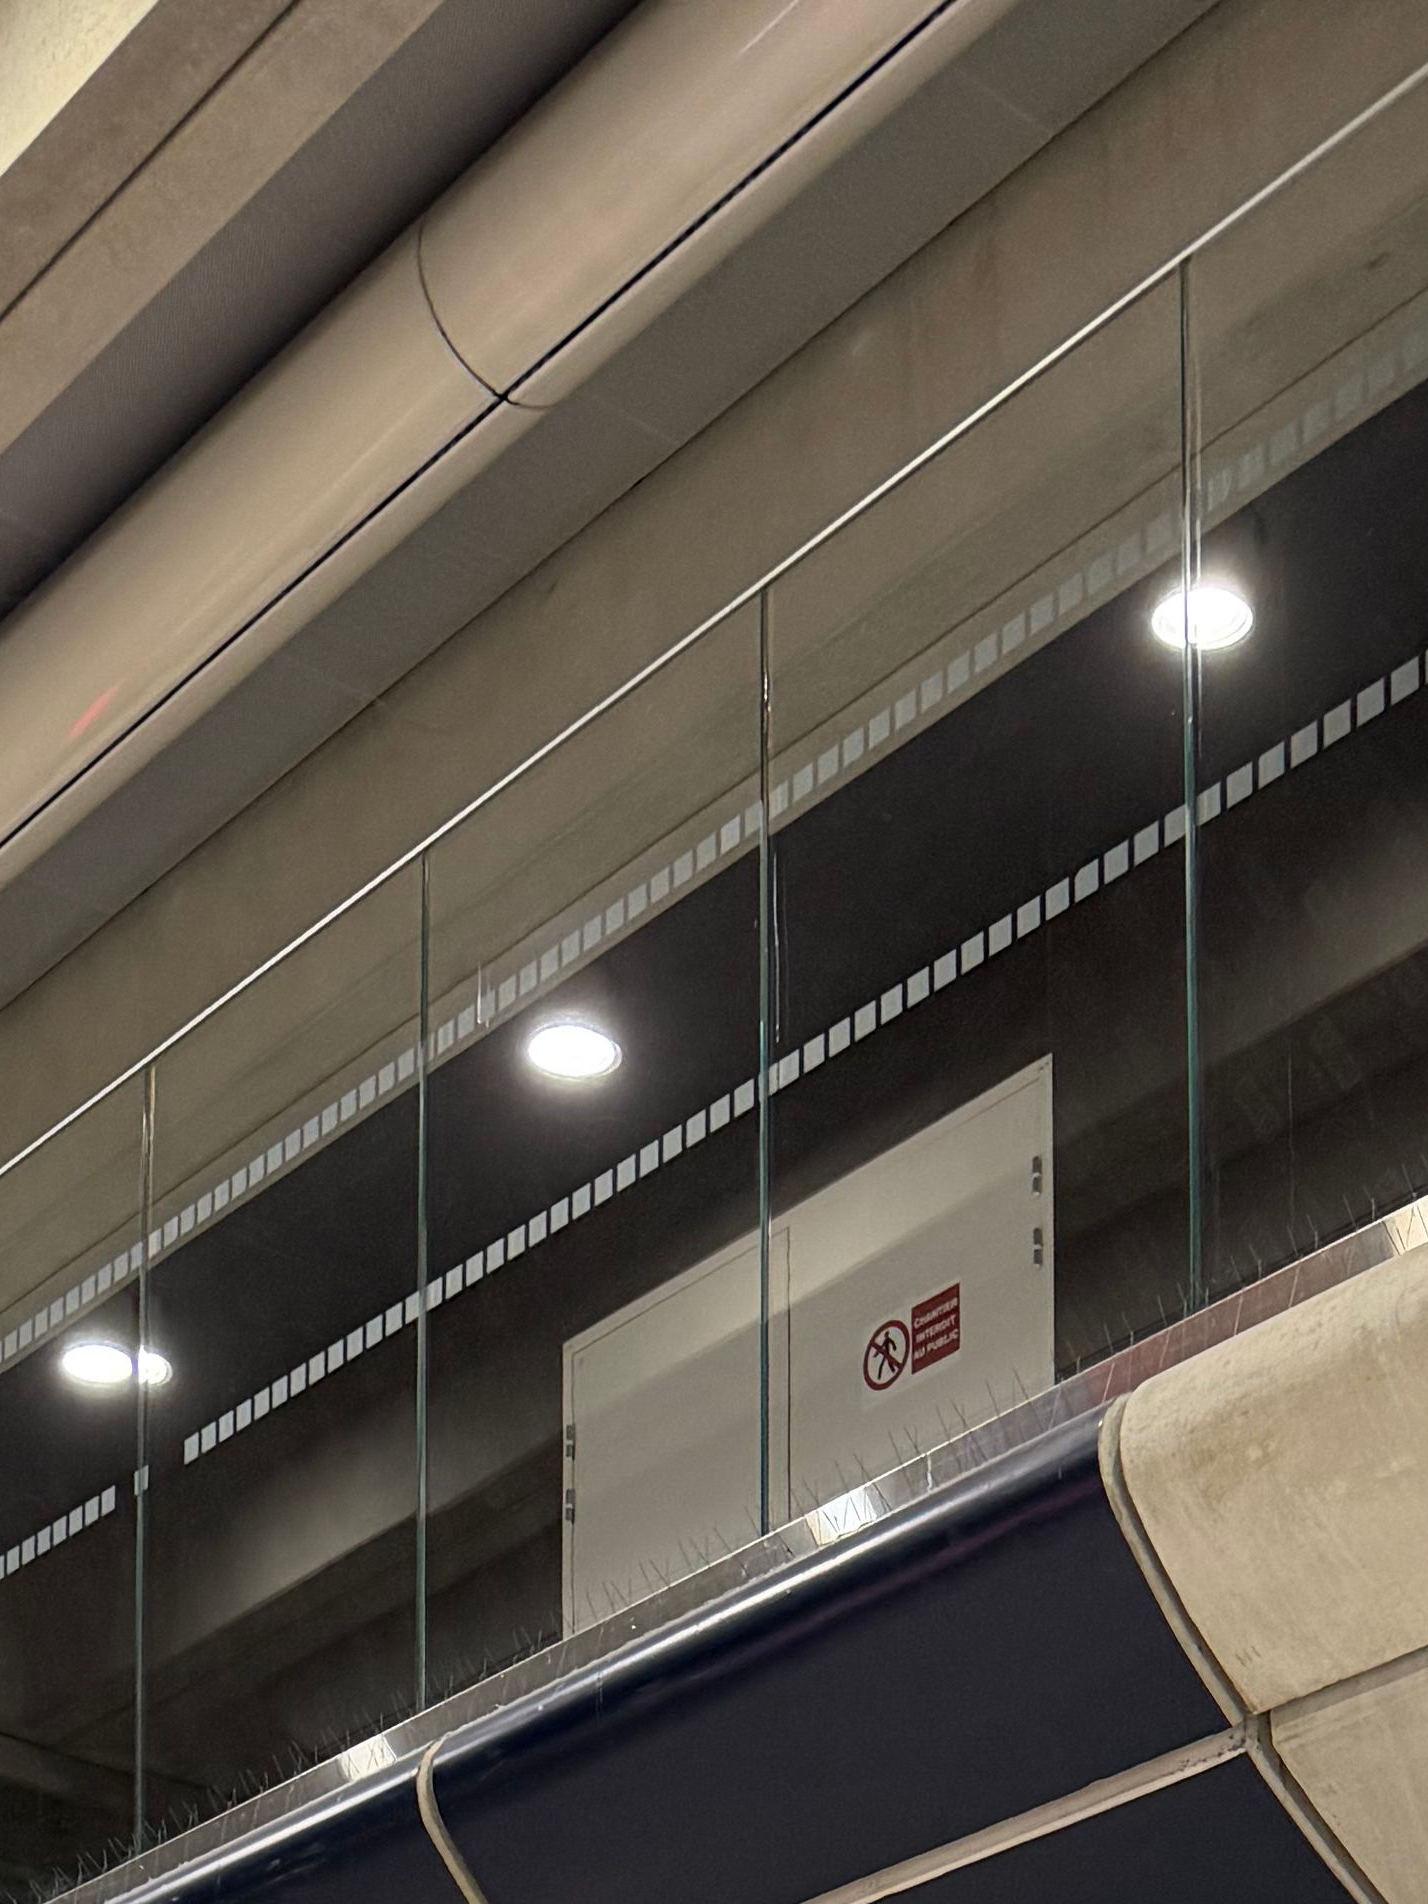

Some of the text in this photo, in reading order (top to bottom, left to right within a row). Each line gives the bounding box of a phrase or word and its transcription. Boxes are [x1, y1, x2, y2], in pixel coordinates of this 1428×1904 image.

[915, 1314, 957, 1343] INTERDIT
[914, 1329, 959, 1360] AU PUBLIC
